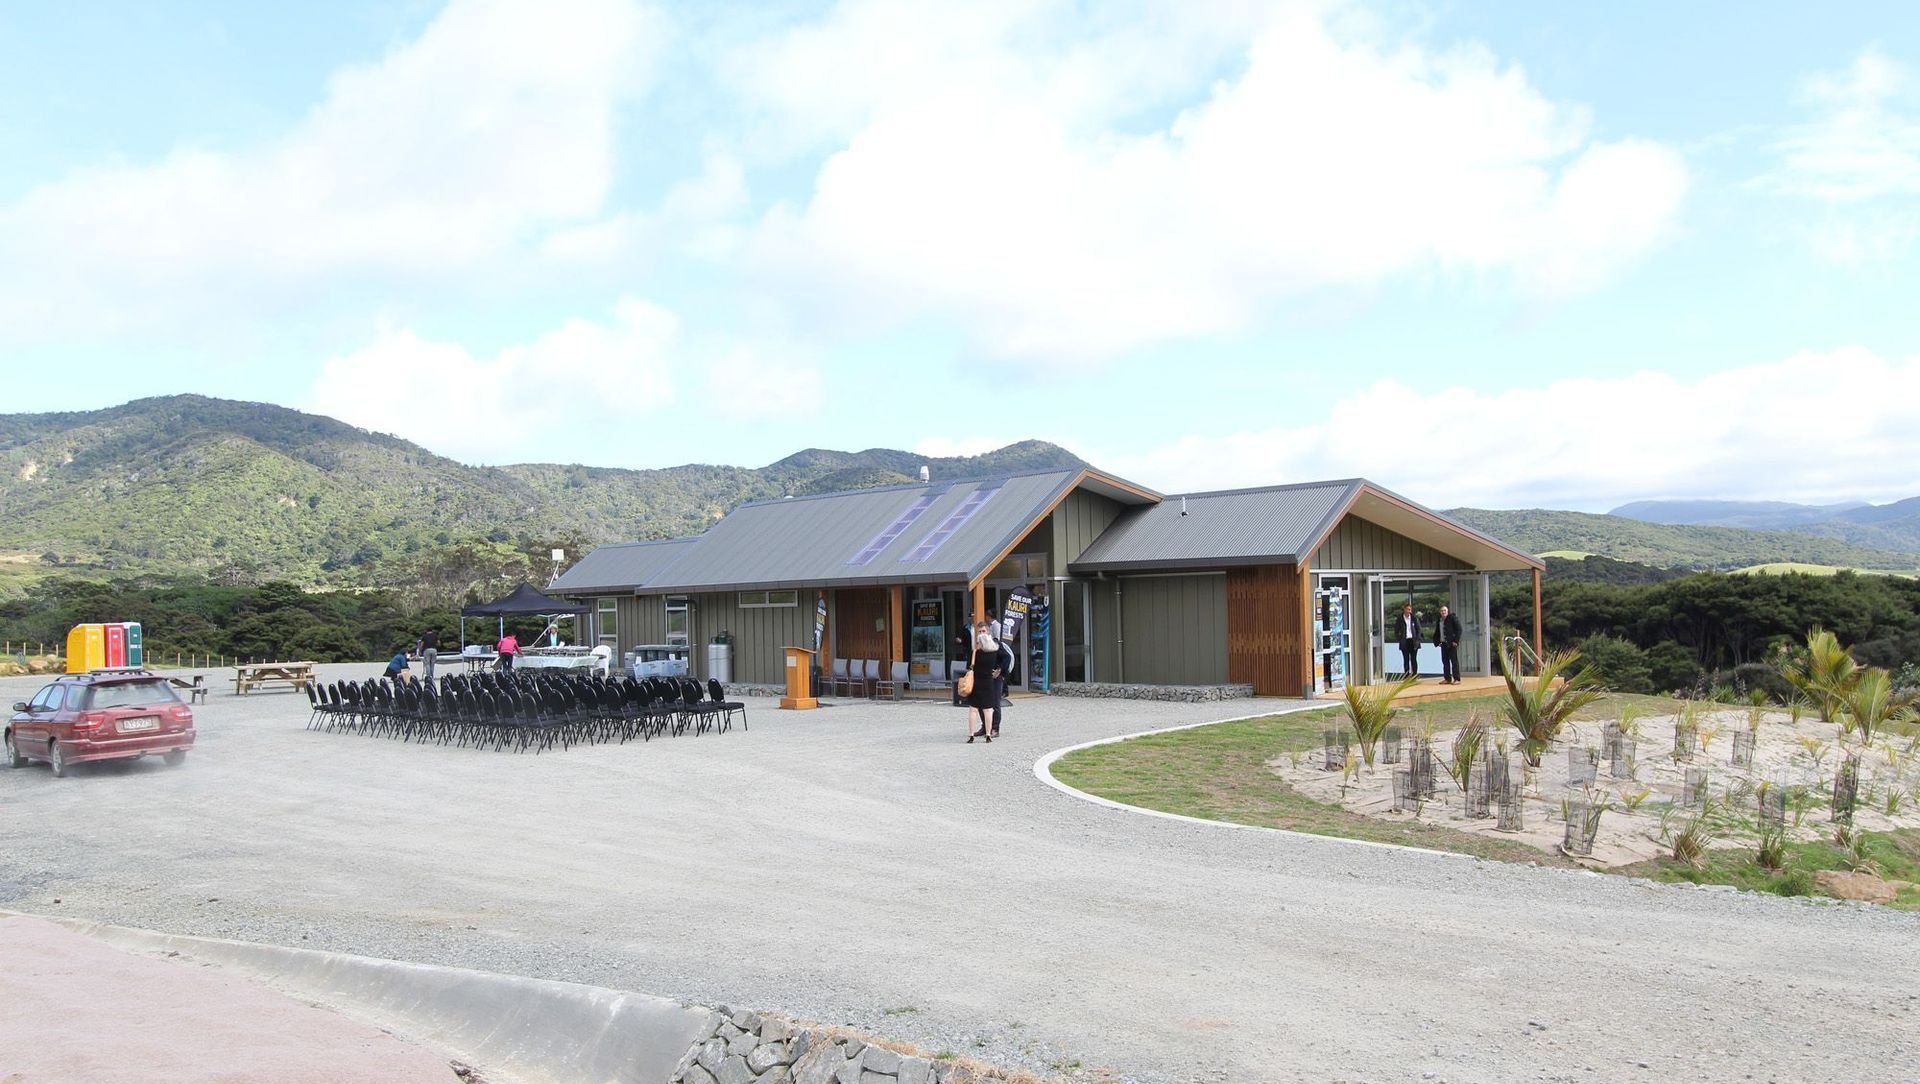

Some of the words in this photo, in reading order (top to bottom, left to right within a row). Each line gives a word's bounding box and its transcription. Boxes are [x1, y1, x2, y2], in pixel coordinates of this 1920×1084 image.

[1011, 594, 1022, 602] SAVE
[1008, 599, 1028, 613] KAURI
[1005, 609, 1024, 619] FORESTS
